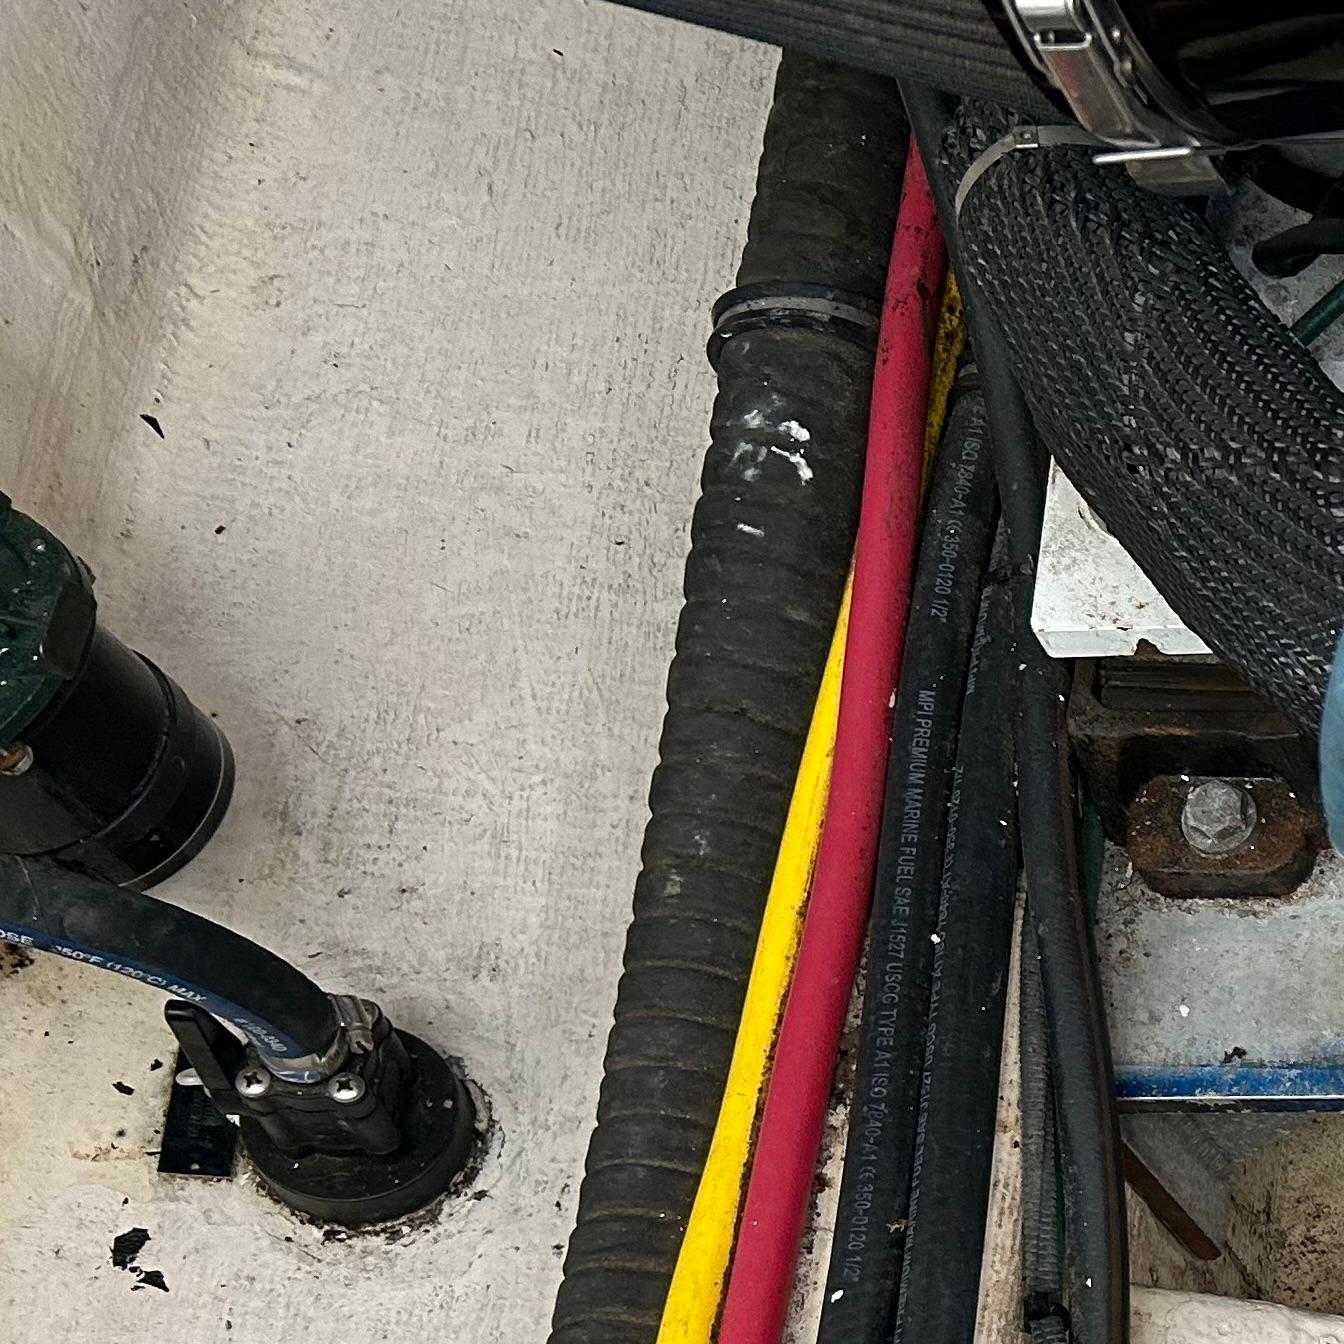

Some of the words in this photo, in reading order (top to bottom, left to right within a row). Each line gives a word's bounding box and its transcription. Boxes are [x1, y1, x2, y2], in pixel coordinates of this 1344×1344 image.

[934, 534, 960, 595] 350-0120
[914, 688, 937, 716] MPI
[904, 716, 933, 786] PREMIUM
[898, 786, 924, 845] MARINE
[894, 845, 917, 884] FUEL
[890, 884, 913, 916] SAE
[885, 918, 909, 958] J1527
[166, 983, 207, 1002] MAX
[879, 961, 904, 1005] USCG
[874, 1008, 898, 1047] TYPE
[871, 1049, 892, 1071] A1
[867, 1071, 890, 1099] ISO
[857, 1100, 887, 1162] 7840-A1
[845, 1181, 875, 1252] 350-0120
